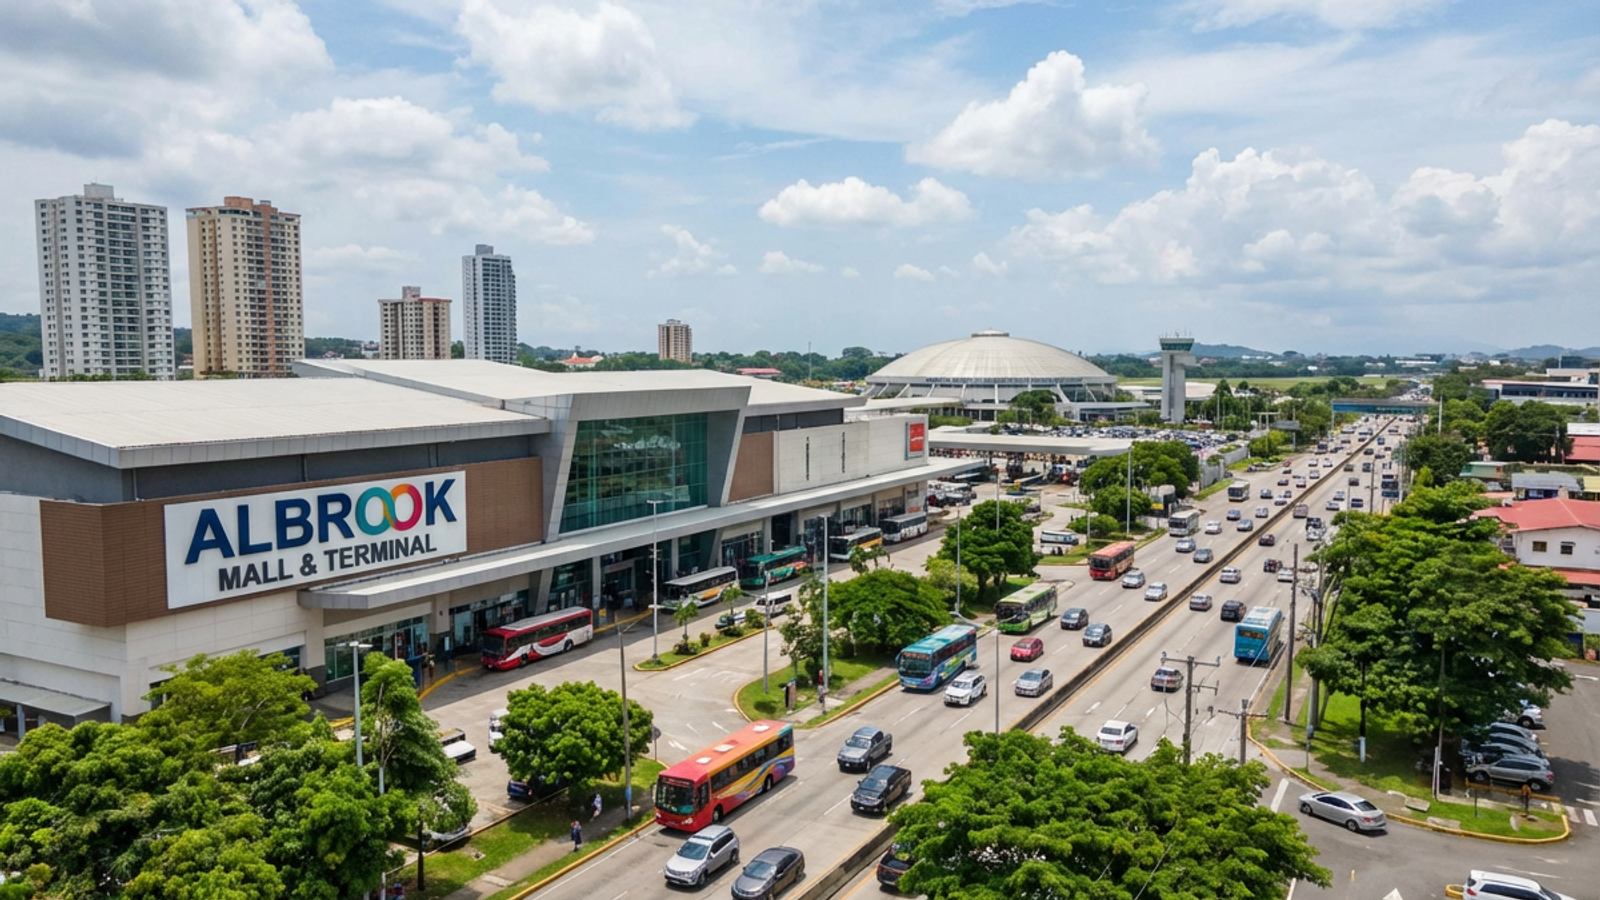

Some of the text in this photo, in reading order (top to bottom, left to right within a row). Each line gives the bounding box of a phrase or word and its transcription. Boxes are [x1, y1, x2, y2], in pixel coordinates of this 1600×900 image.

[185, 479, 457, 564] ALBROOK
[219, 534, 437, 591] MALL & TERMINAL
